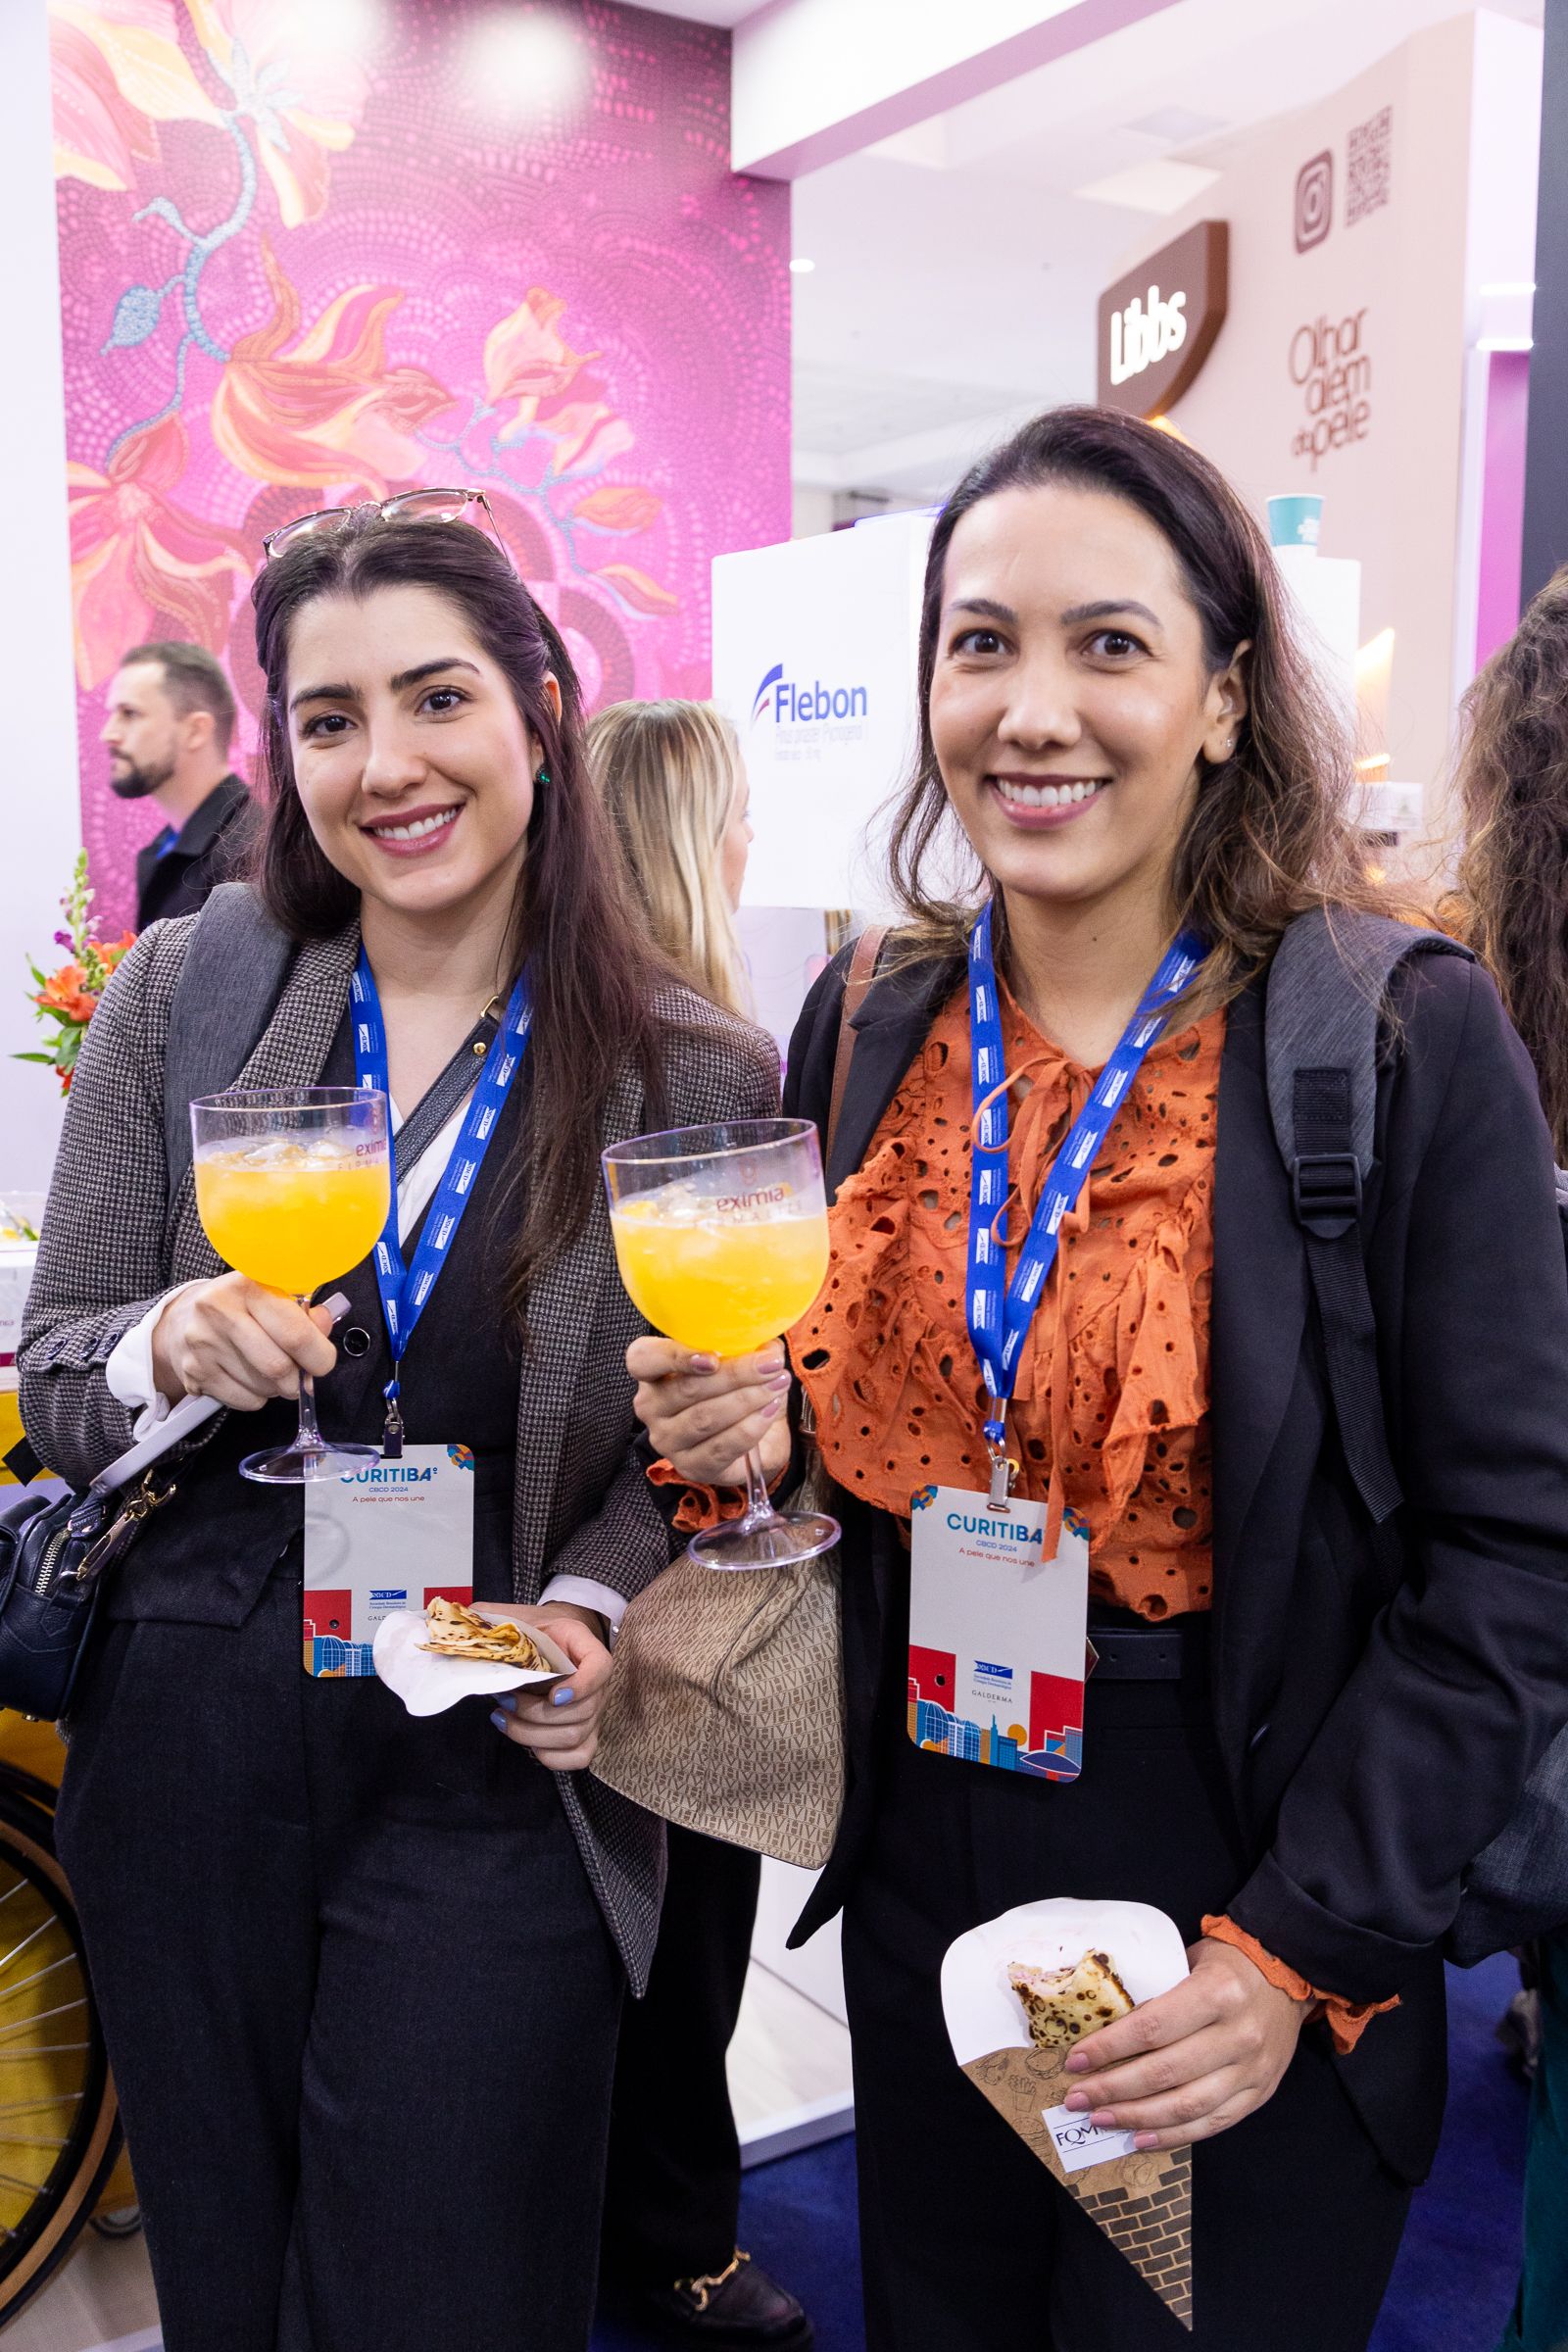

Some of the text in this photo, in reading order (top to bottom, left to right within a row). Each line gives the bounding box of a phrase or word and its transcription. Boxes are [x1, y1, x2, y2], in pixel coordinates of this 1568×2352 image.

[1110, 284, 1187, 386] Libbs
[1290, 307, 1368, 384] Olhar
[775, 680, 868, 723] Flebon
[715, 1187, 785, 1212] eximia
[360, 1495, 377, 1504] pele
[966, 1549, 984, 1558] pele
[985, 1552, 1002, 1562] que
[1018, 1559, 1035, 1568] une
[998, 1543, 1018, 1552] 2024
[971, 1690, 1013, 1704] GALDERMA
